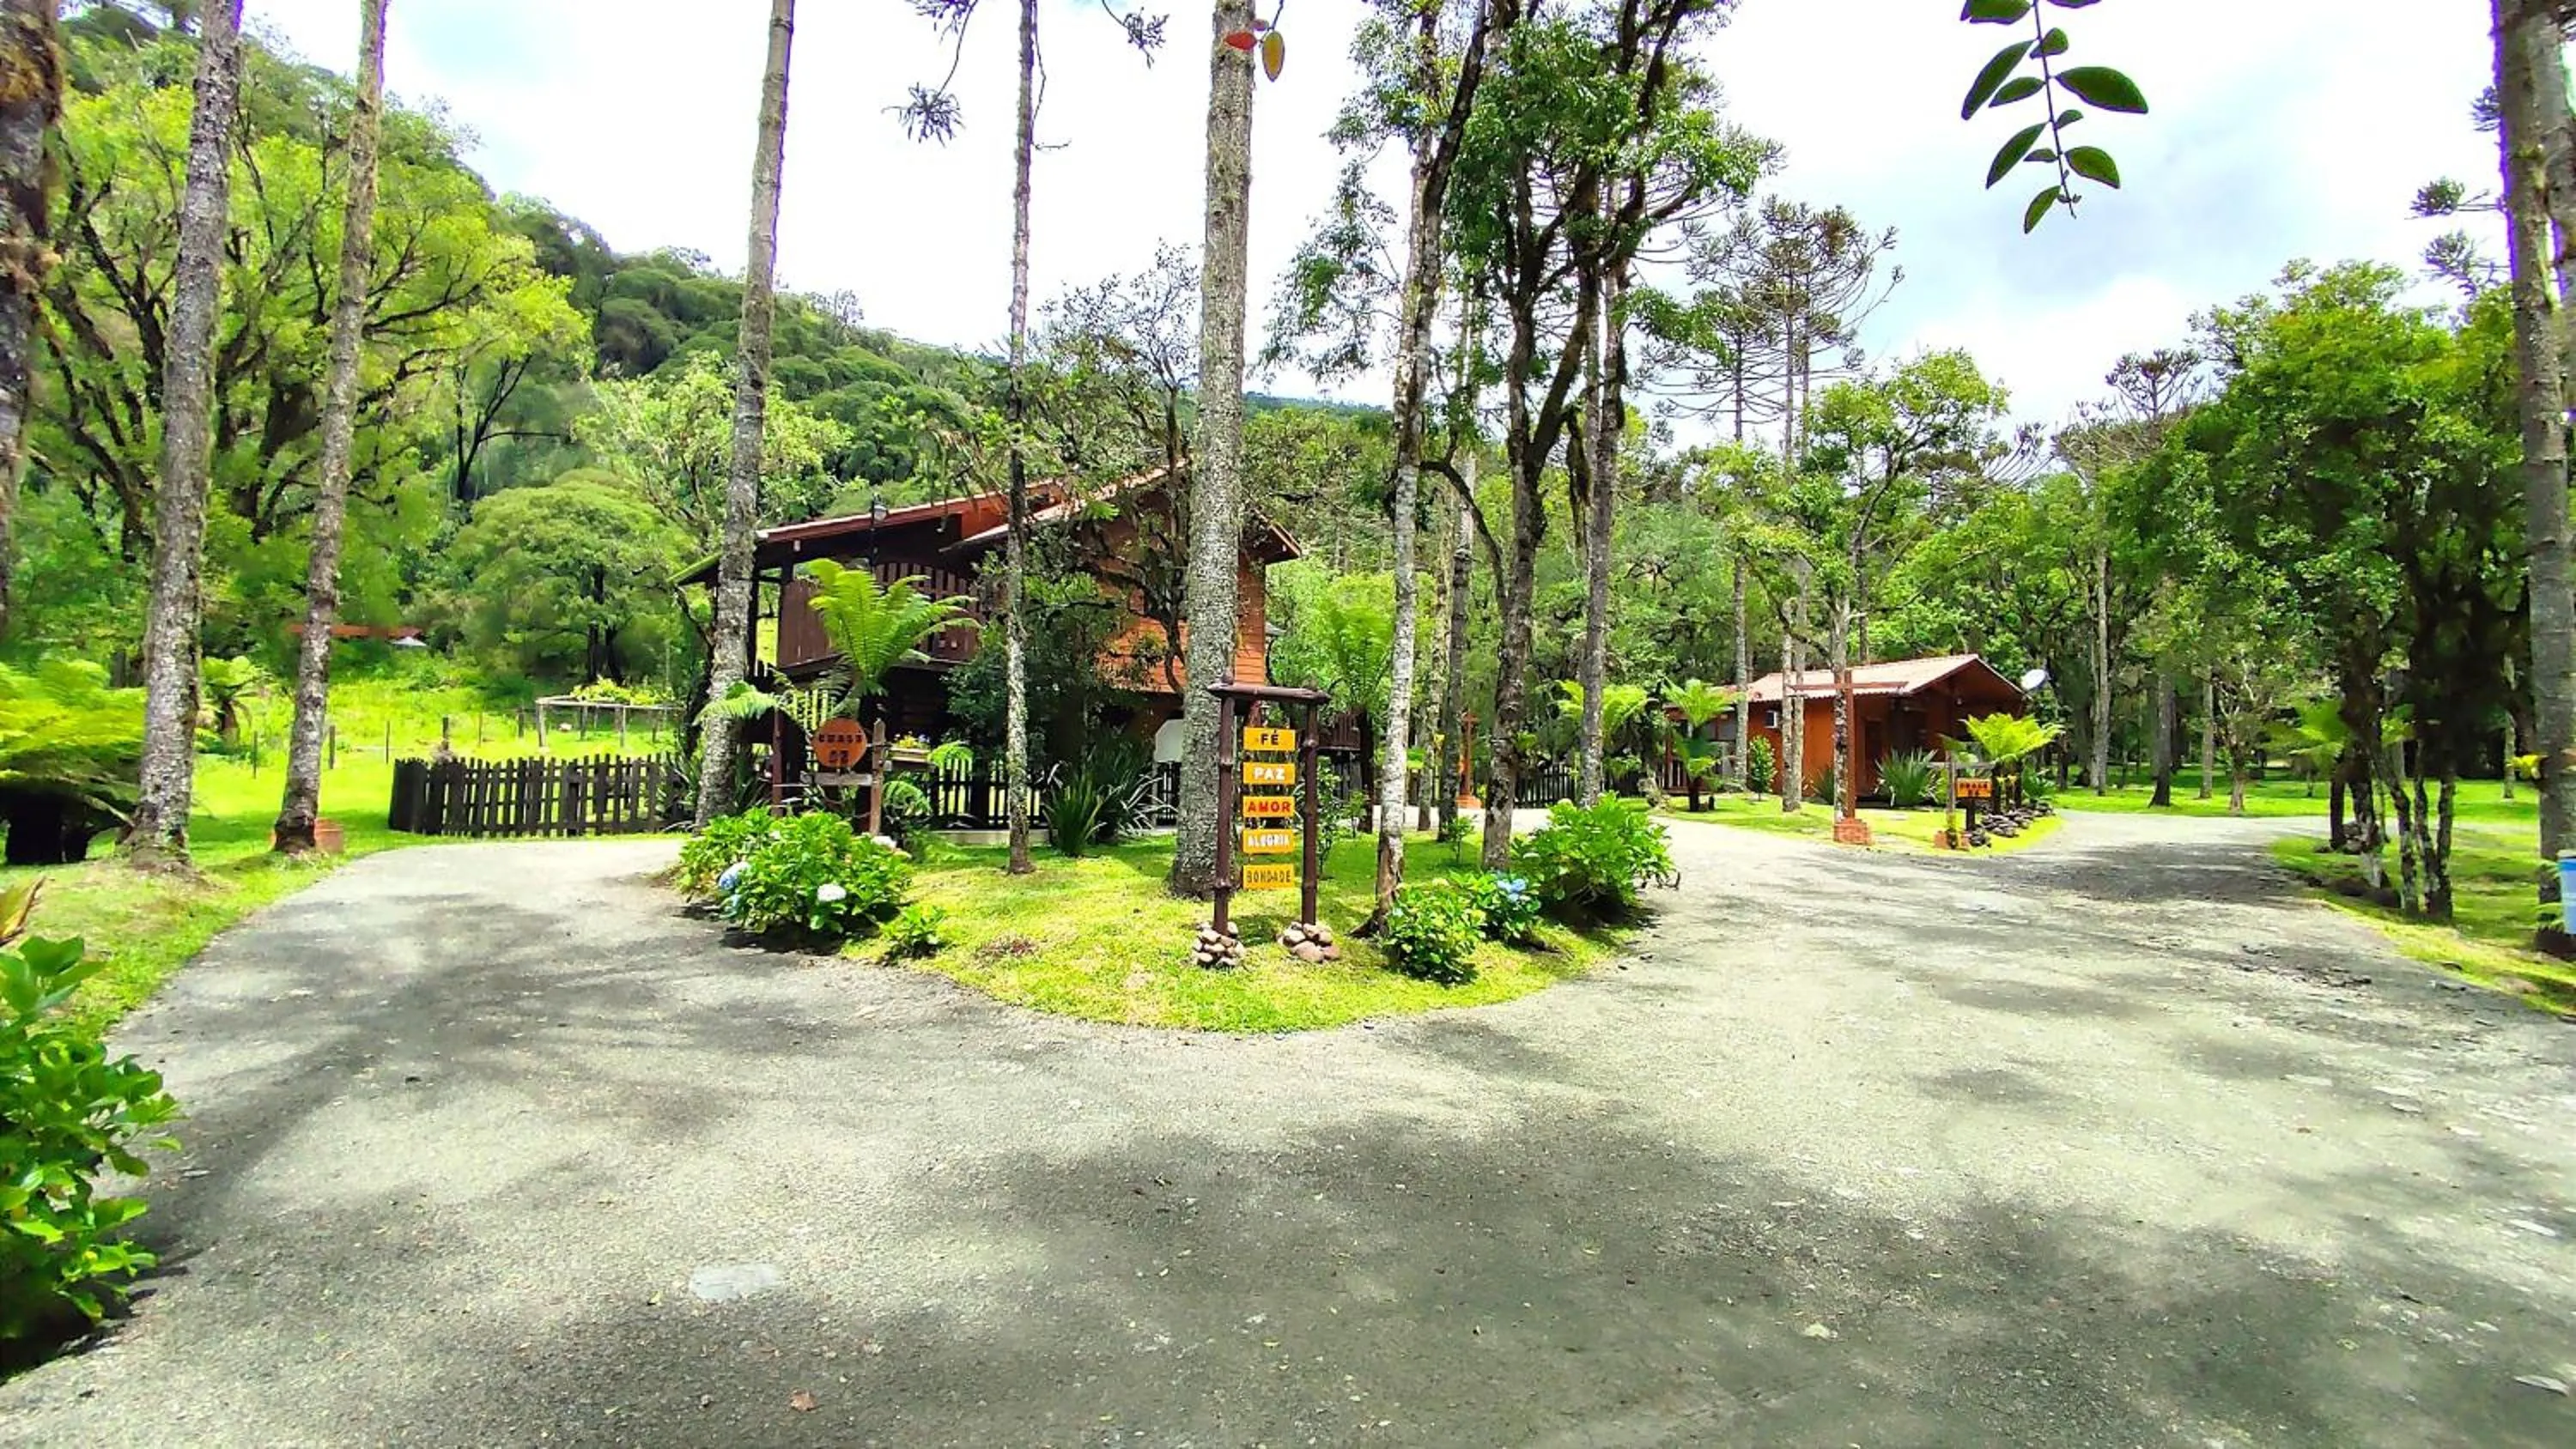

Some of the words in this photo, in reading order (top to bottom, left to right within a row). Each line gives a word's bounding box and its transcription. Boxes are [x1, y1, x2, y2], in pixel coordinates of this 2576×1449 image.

[1261, 730, 1279, 745] FÉ
[1254, 767, 1285, 780] PAZ
[1248, 801, 1291, 812] AMOR
